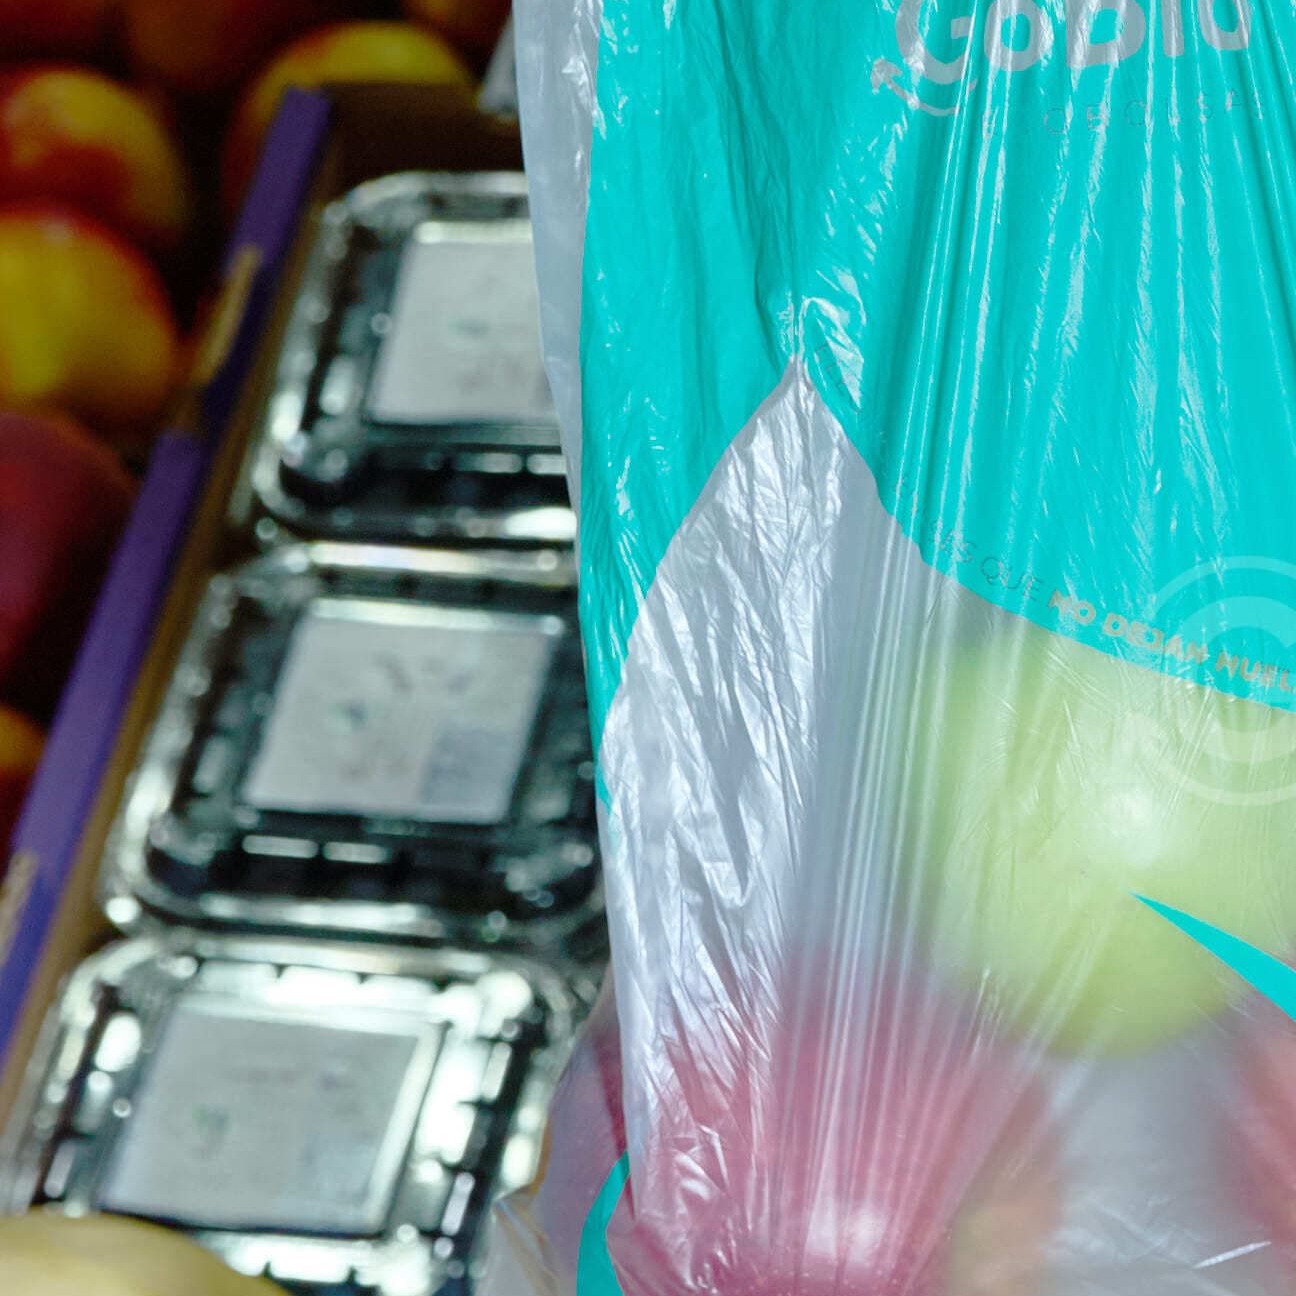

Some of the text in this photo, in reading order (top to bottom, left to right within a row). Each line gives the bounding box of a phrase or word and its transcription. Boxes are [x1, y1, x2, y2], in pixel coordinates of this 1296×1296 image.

[980, 556, 1045, 603] QUE
[1048, 589, 1096, 626] NO
[1102, 612, 1208, 665] DEJAN
